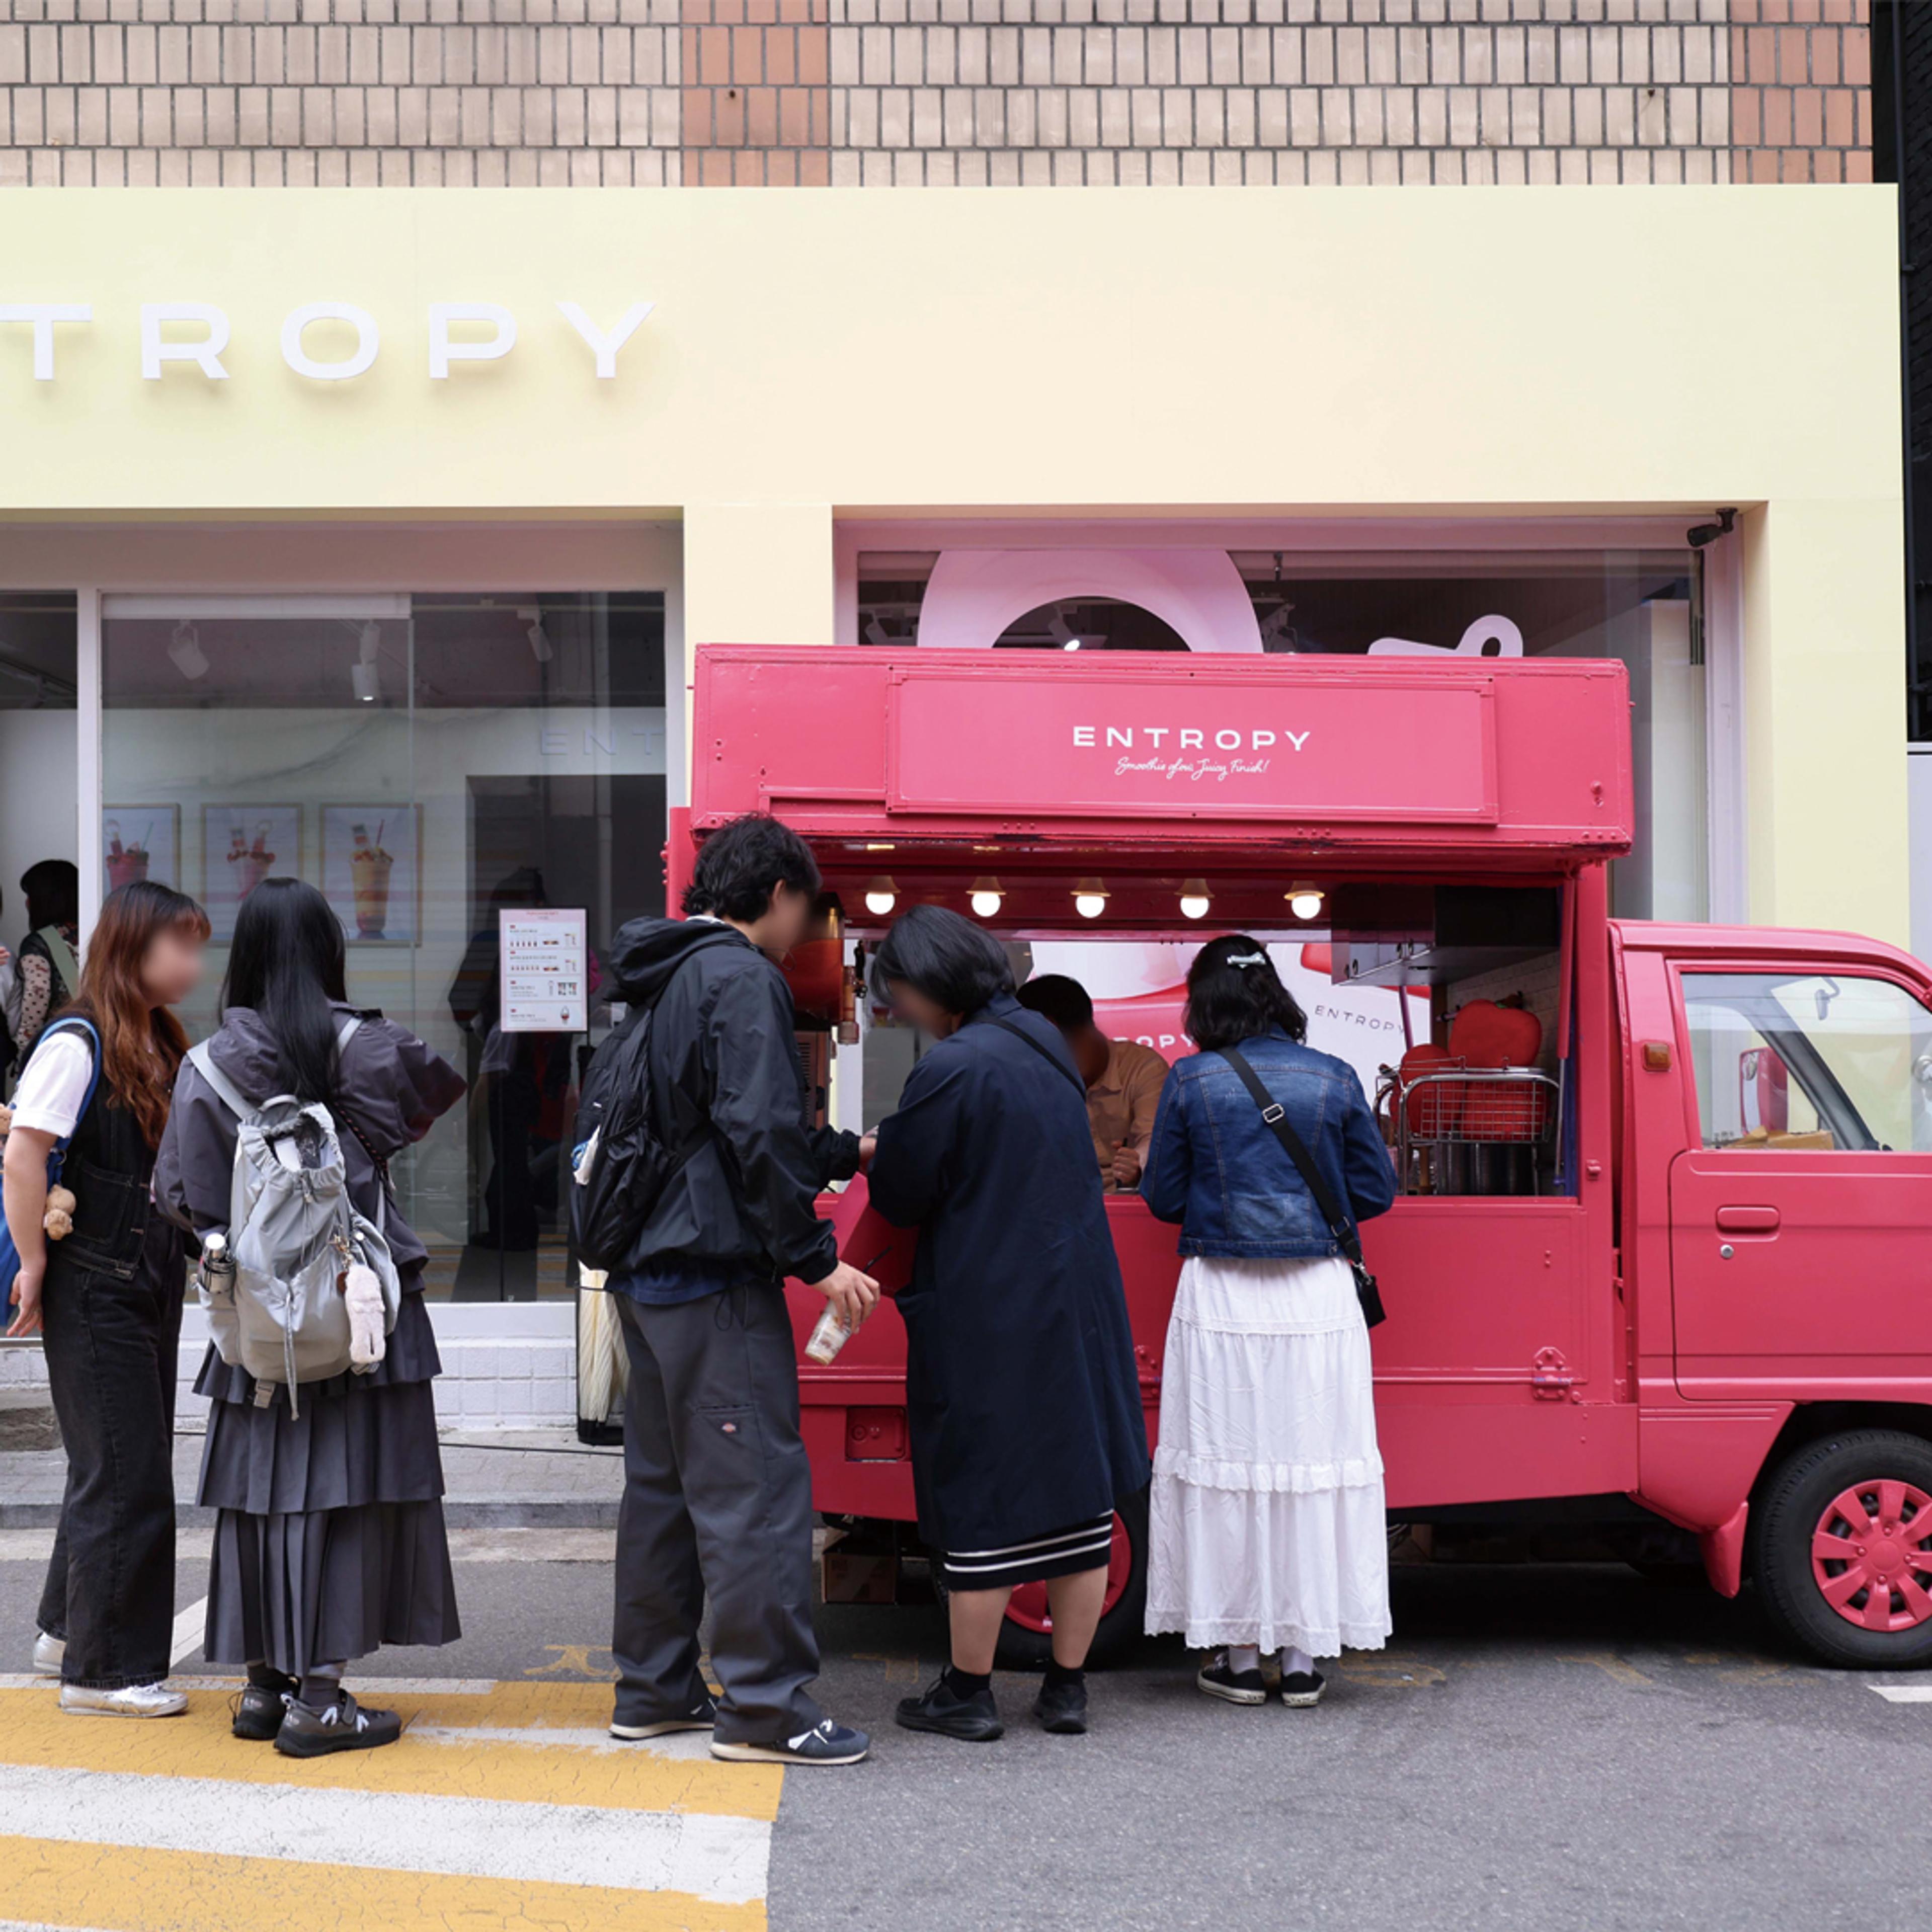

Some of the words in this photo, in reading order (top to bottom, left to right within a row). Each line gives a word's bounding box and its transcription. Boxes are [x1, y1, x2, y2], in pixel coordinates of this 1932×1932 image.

[0, 302, 657, 381] TROPY
[1073, 726, 1311, 752] ENTROPY
[1114, 756, 1166, 775] Smoothie
[1112, 1034, 1193, 1049] OPY
